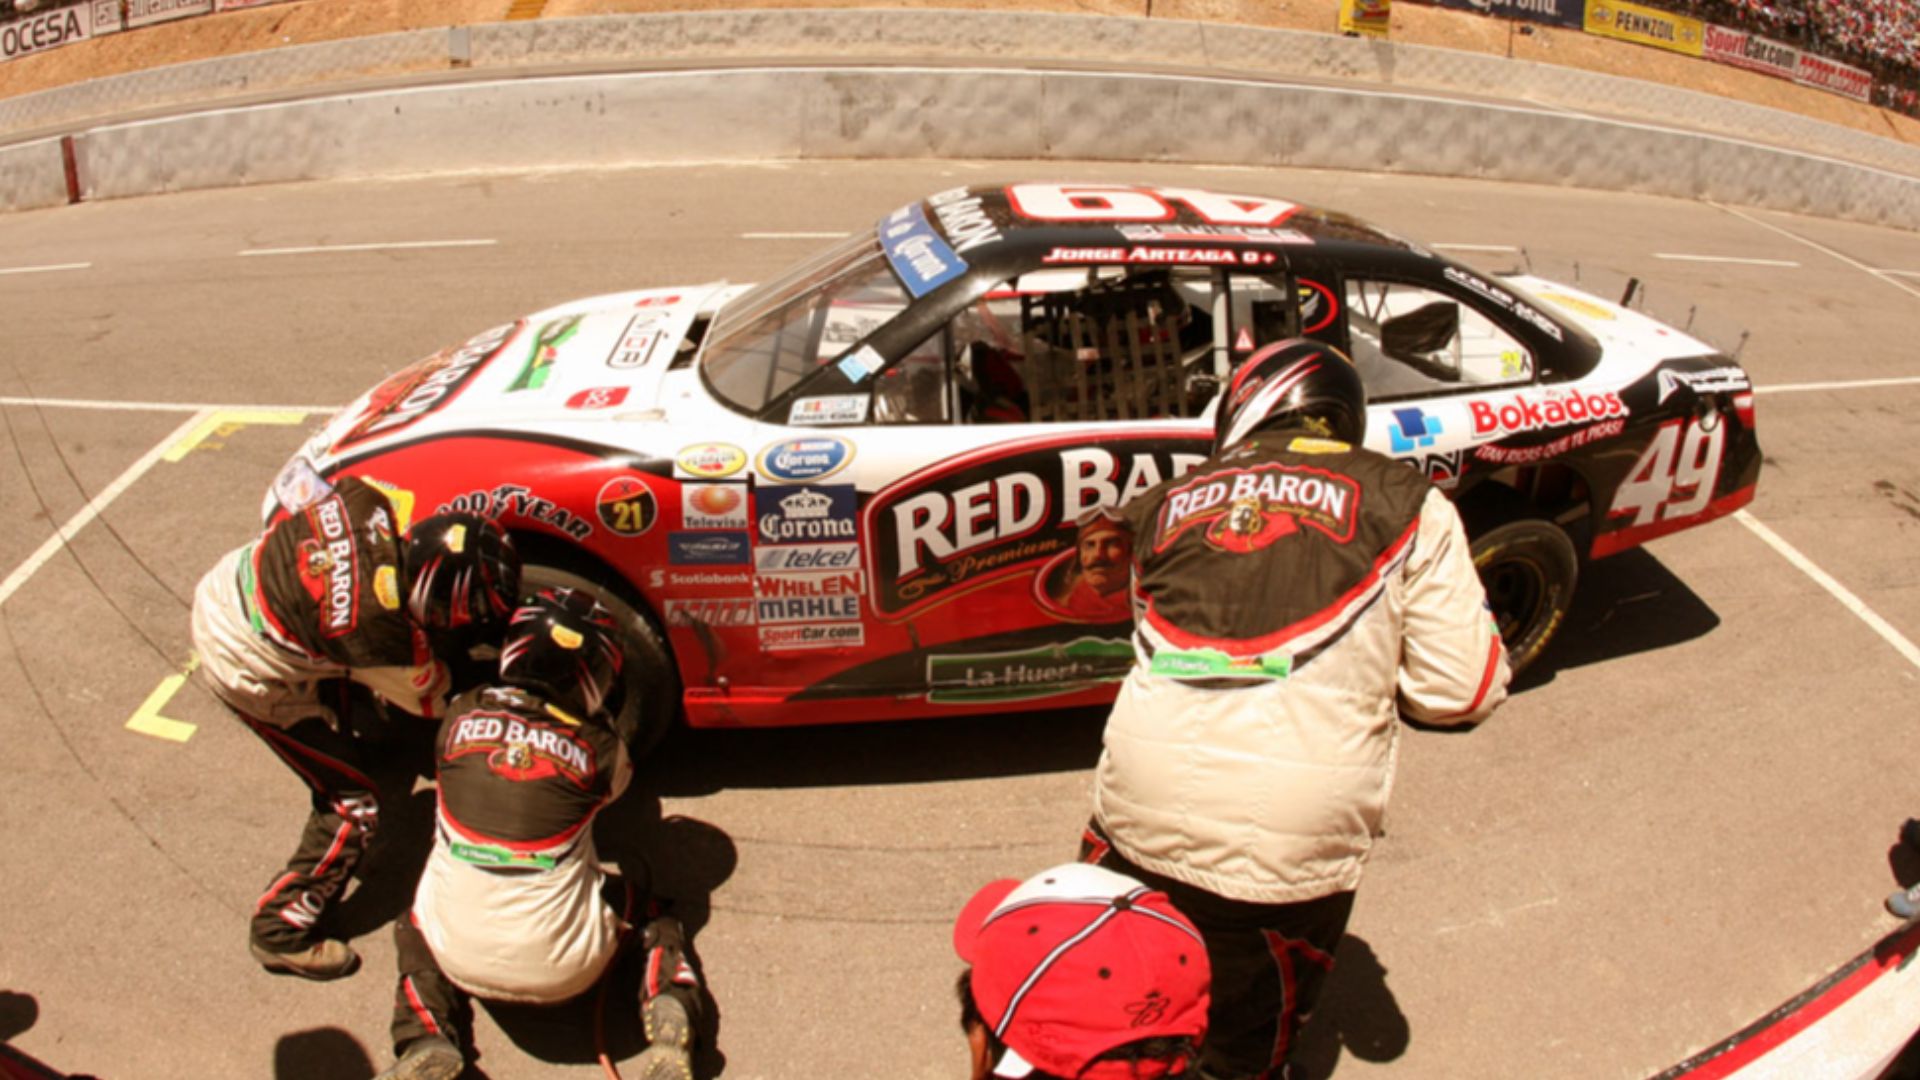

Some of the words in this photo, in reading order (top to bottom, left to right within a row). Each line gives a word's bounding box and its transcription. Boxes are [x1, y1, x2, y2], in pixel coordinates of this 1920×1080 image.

[2, 9, 82, 56] OCESA
[1614, 10, 1675, 41] PENNZOIL
[1045, 247, 1126, 262] JORGE
[1130, 246, 1236, 263] ARTEAGA
[775, 452, 830, 471] Corona
[1610, 414, 1726, 526] 49
[612, 501, 642, 530] 21
[1165, 482, 1228, 529] RED
[1229, 473, 1347, 520] BARON
[316, 499, 344, 539] RED
[685, 517, 747, 529] Televisa
[759, 513, 856, 542] Corona
[892, 471, 1046, 578] RED
[784, 548, 856, 568] telcel
[328, 539, 351, 629] BARON
[670, 570, 749, 585] Scotiabank
[757, 571, 861, 598] WHELEN
[760, 598, 857, 619] MAHLE
[763, 626, 860, 643] SportCar.com
[965, 667, 994, 686] La
[1003, 661, 1093, 684] Huerta
[454, 717, 502, 745] RED
[504, 718, 588, 775] BARON
